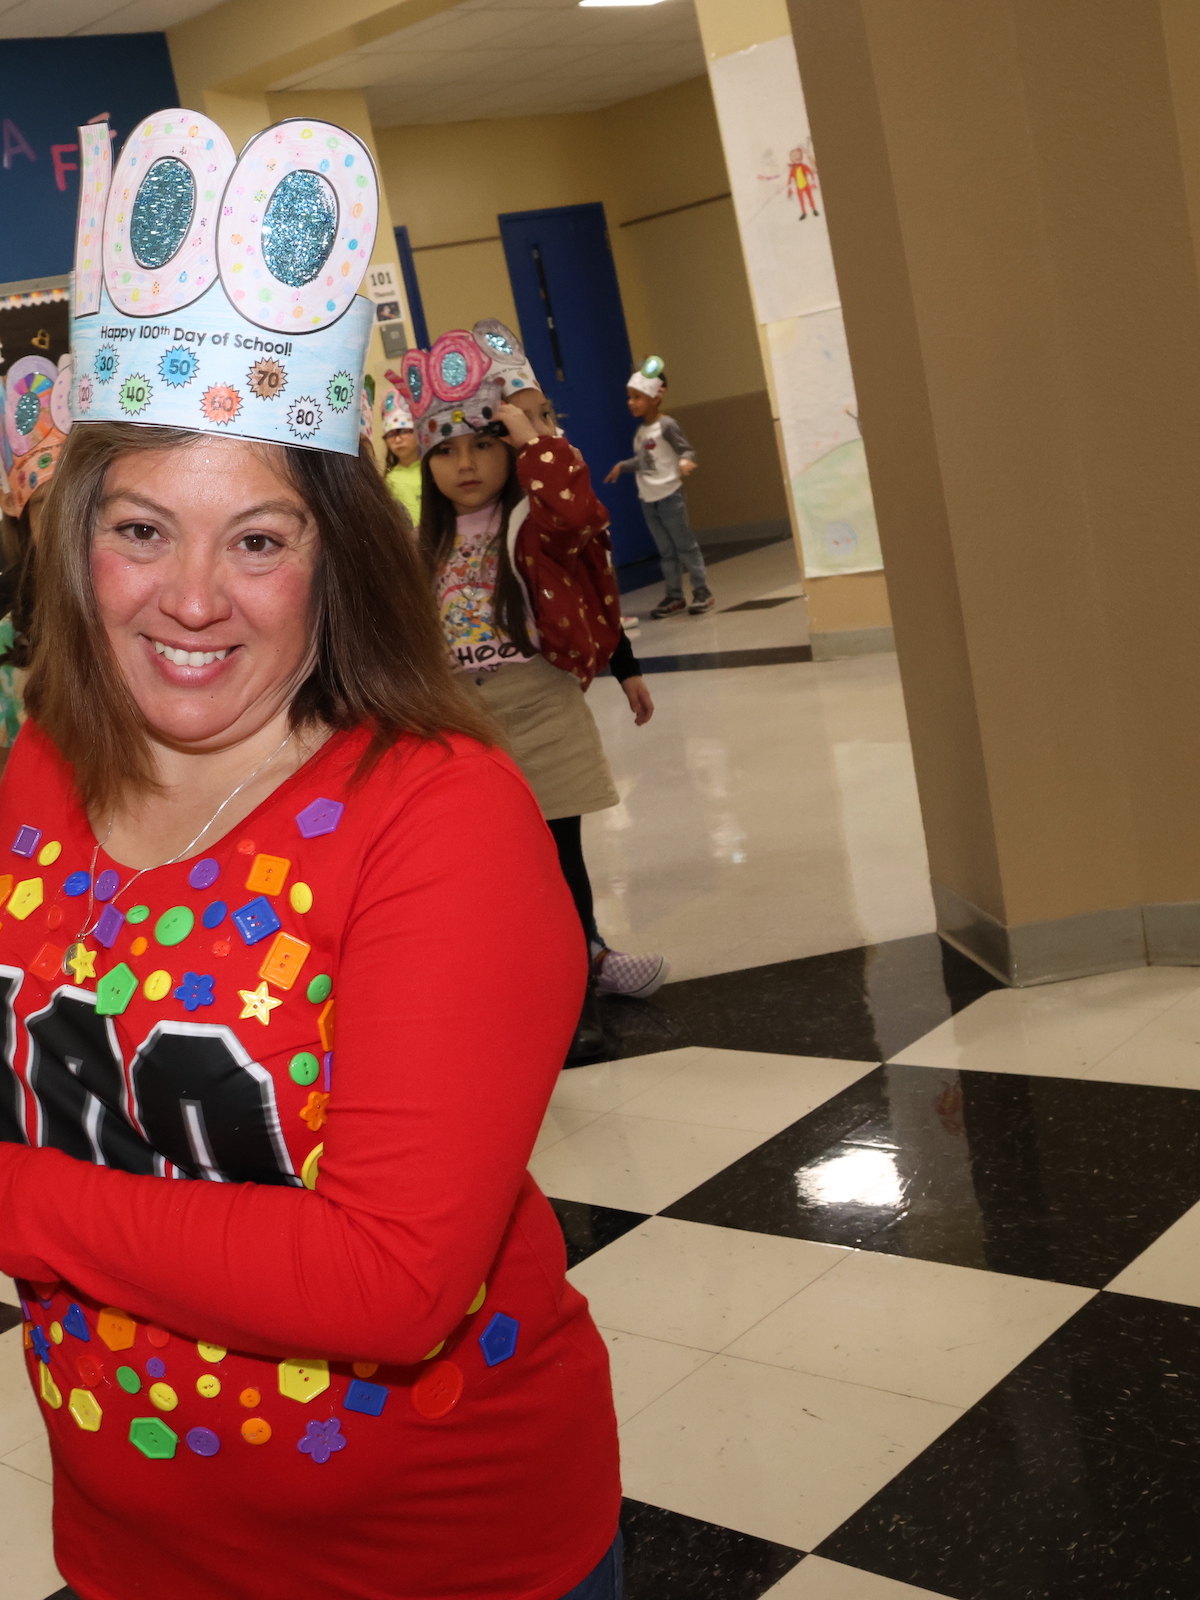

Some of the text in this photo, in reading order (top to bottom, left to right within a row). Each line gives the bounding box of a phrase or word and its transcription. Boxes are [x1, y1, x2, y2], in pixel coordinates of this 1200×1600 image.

[370, 272, 392, 286] 101
[100, 325, 293, 357] Happy 100th Day of School!
[100, 356, 114, 371] 30
[169, 359, 190, 376] 50
[258, 370, 279, 389] 70
[81, 386, 90, 401] 20
[126, 386, 145, 401] 40
[334, 384, 348, 402] 90
[210, 394, 234, 412] 60
[296, 409, 314, 426] 80
